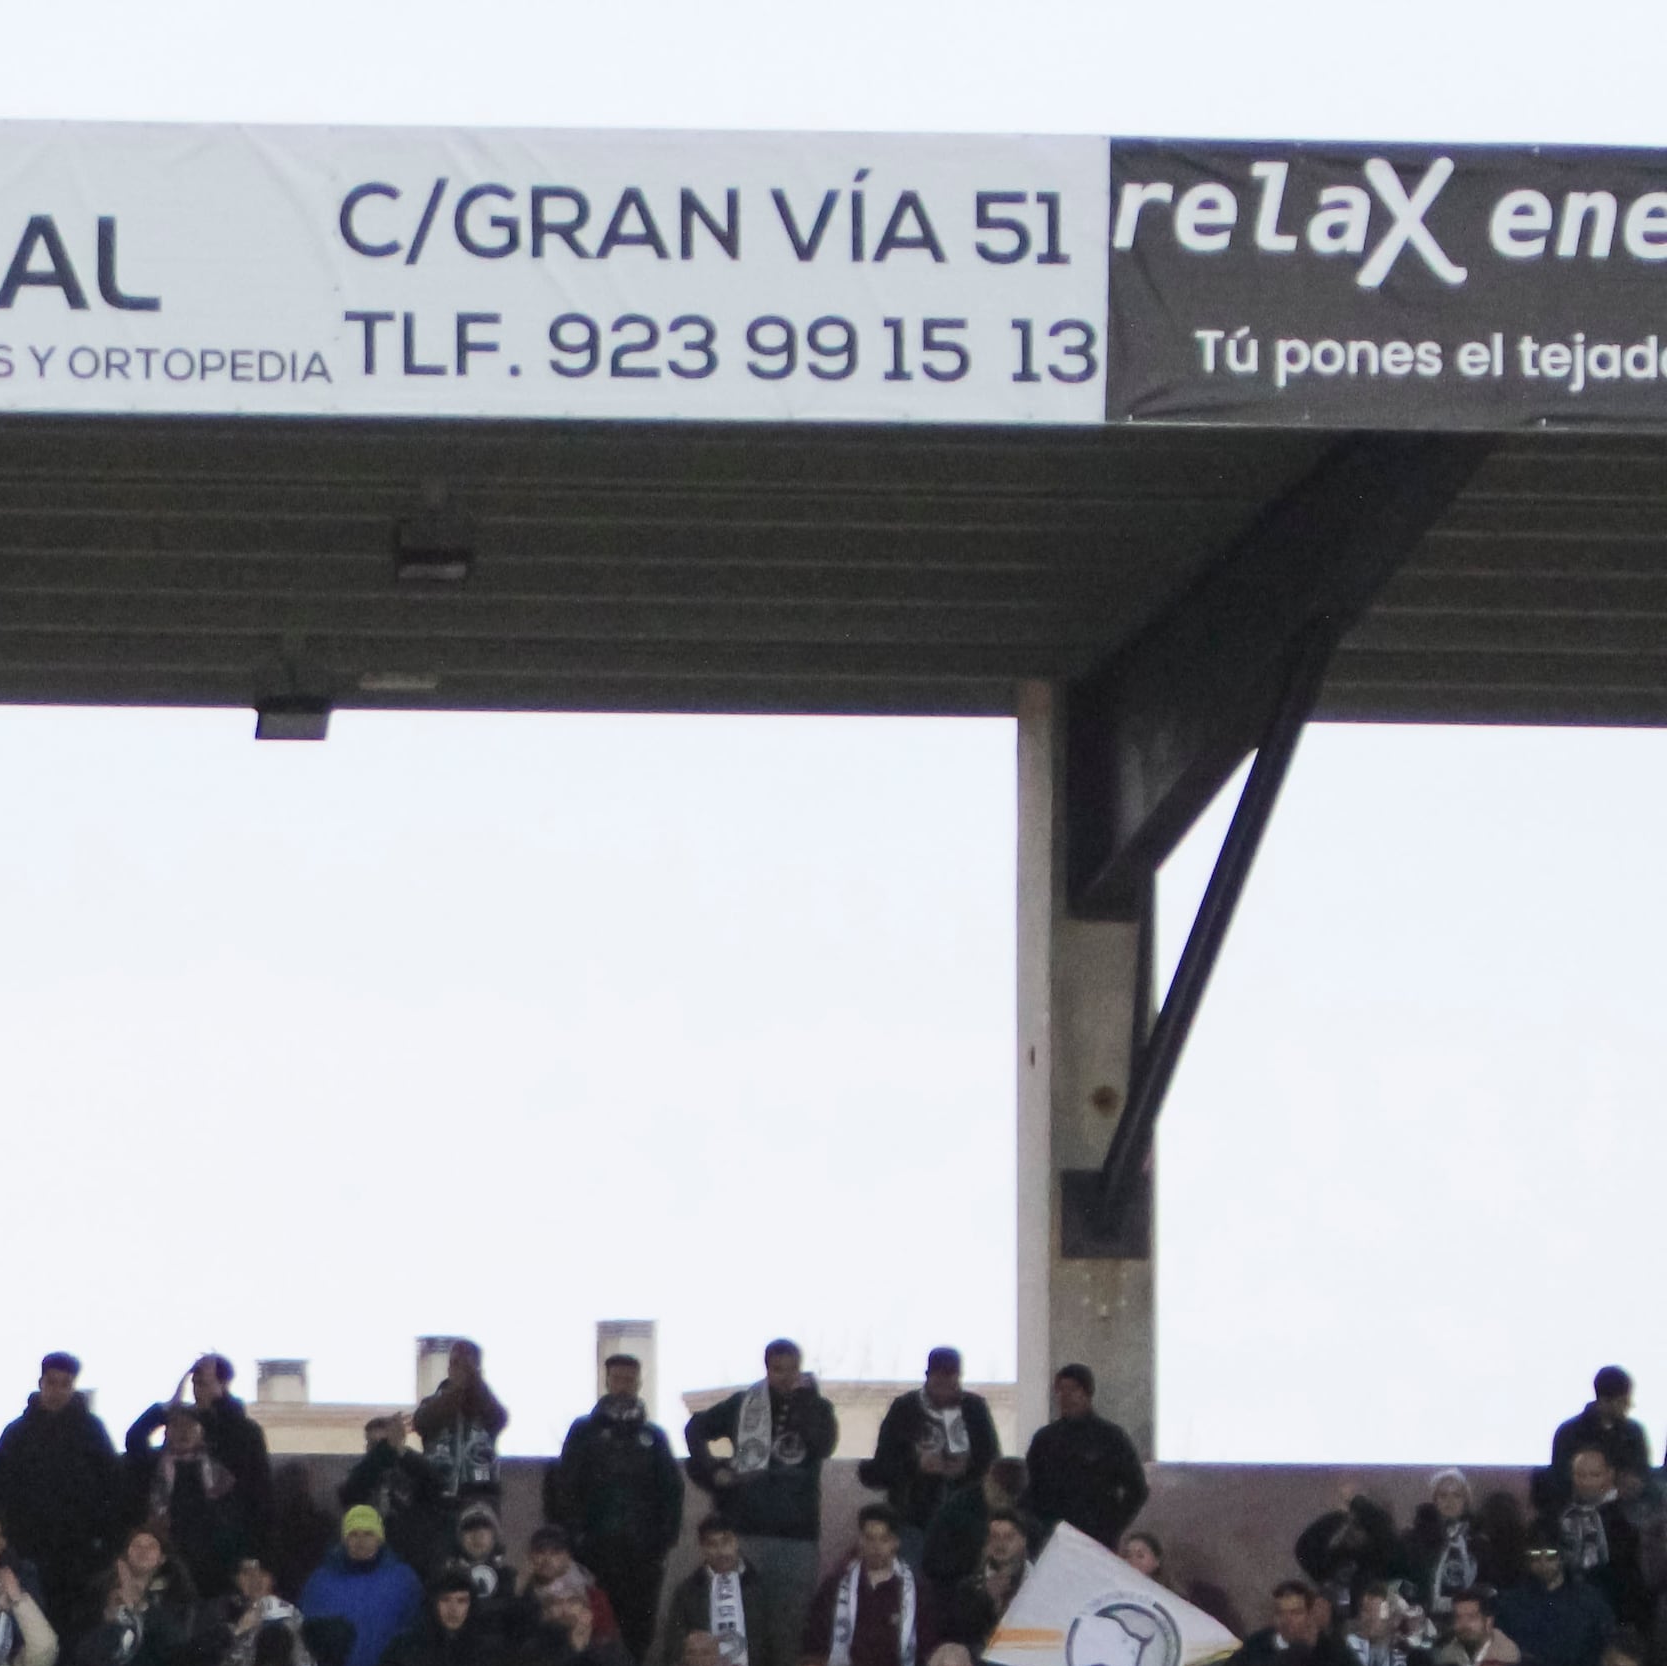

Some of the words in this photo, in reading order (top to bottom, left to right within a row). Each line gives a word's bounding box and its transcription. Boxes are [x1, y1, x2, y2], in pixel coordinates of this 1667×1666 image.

[338, 178, 742, 266] C/GRAN
[769, 168, 948, 266] VÍA
[971, 190, 1072, 265] 51
[26, 346, 58, 381] Y
[66, 345, 334, 386] ORTOPEDIA
[346, 310, 523, 378] TLF.
[547, 312, 720, 382] 923
[744, 314, 860, 383] 99
[881, 316, 970, 383] 15
[1011, 317, 1099, 384] 13
[1193, 329, 1259, 376] Tú
[1274, 337, 1445, 394] pones
[1456, 328, 1503, 377] el
